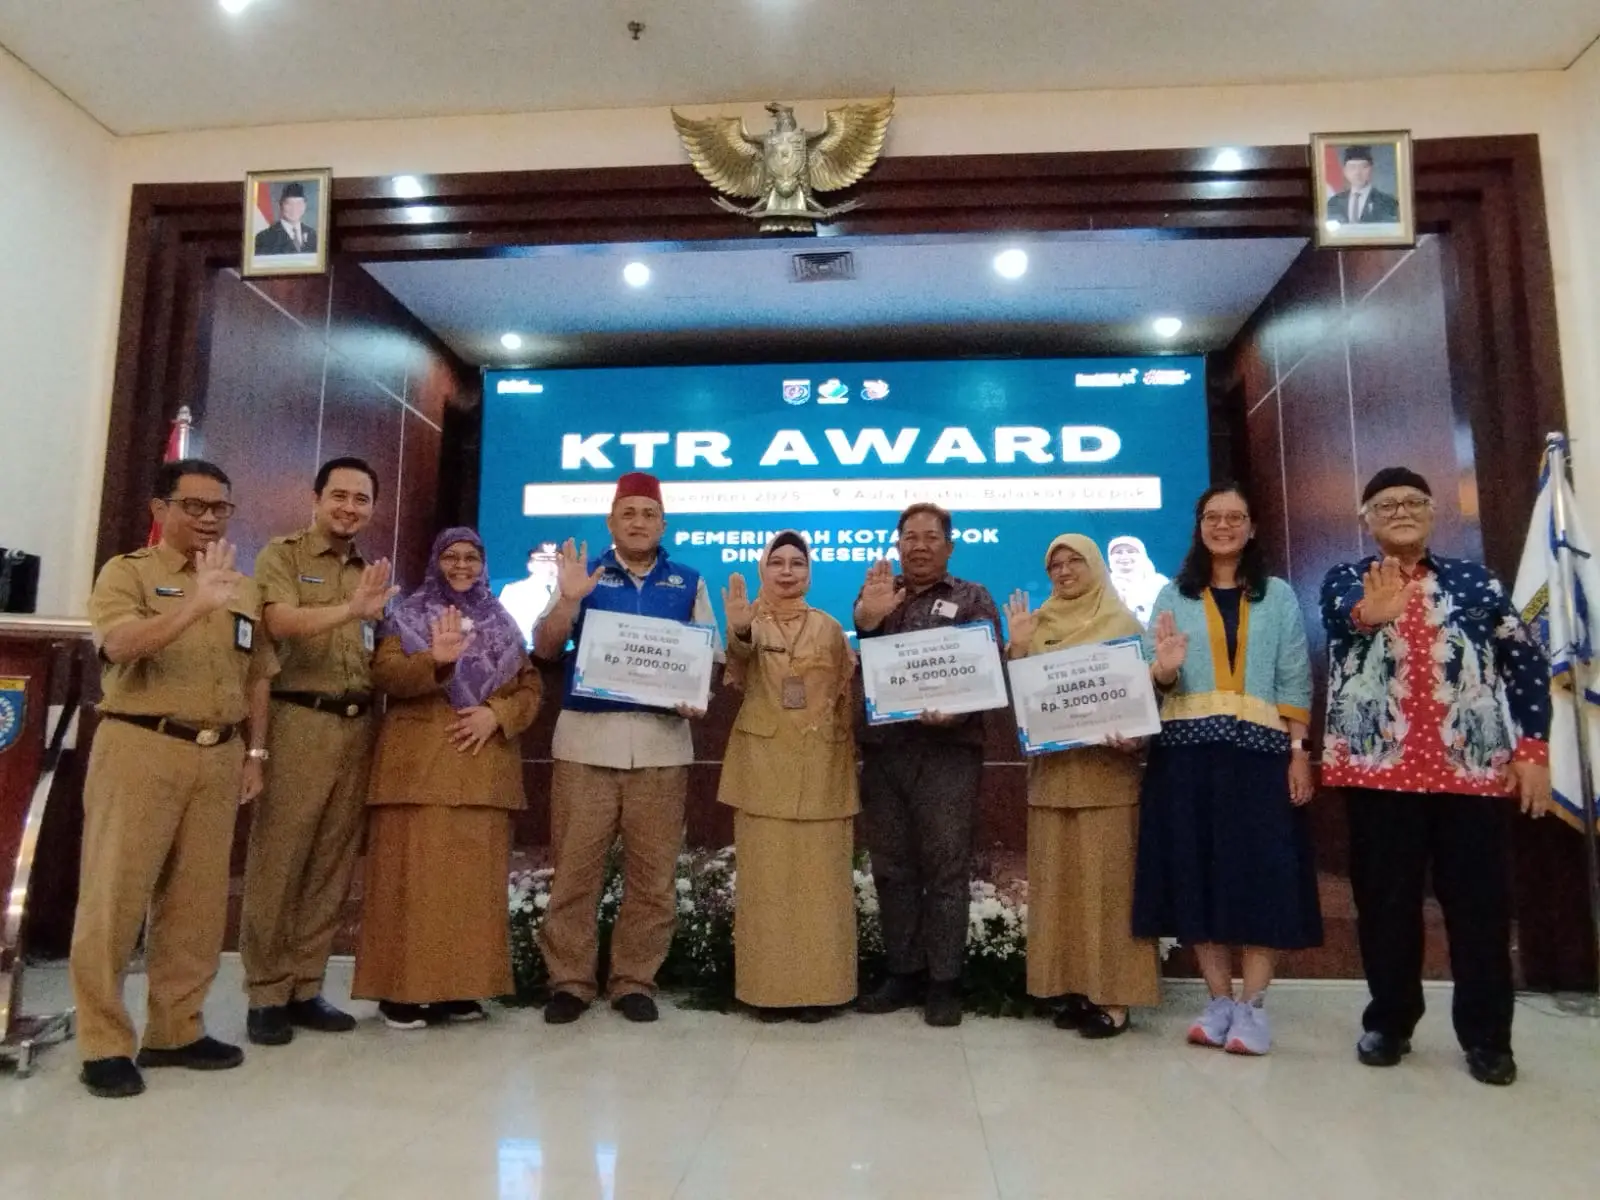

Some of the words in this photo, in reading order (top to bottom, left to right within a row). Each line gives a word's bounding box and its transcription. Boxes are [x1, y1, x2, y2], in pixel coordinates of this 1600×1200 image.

[561, 431, 734, 470] KTR
[759, 424, 1121, 466] AWARD
[674, 529, 830, 545] PEMERINAH
[722, 547, 764, 563] DIN
[810, 547, 900, 562] KESEHA
[624, 643, 662, 656] JUARA
[665, 649, 671, 657] 1
[626, 656, 687, 672] 7.000.000
[905, 656, 946, 670] JUARA
[949, 655, 957, 664] 2
[912, 665, 976, 682] 5.000.000
[1056, 679, 1096, 695] JUARA
[1098, 676, 1106, 687] 3
[1041, 702, 1060, 712] Rp.
[1062, 688, 1127, 709] 3.000.000
